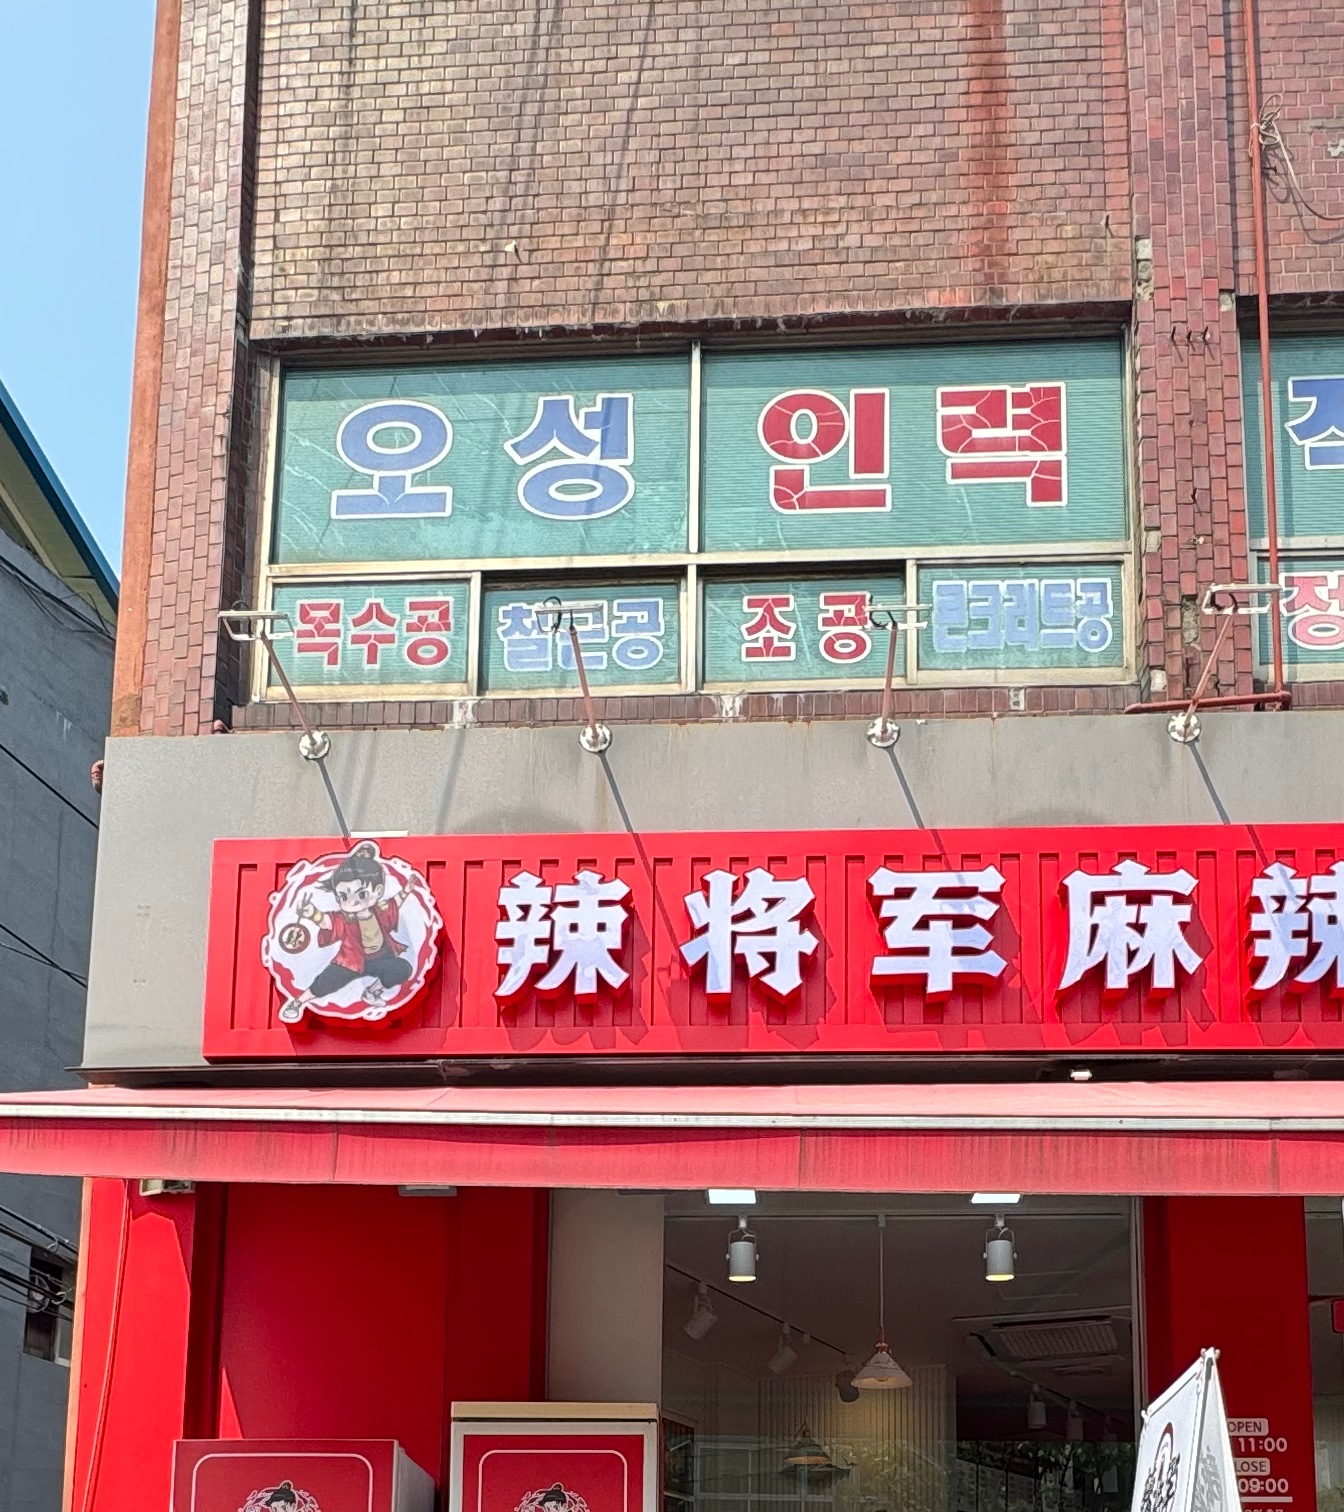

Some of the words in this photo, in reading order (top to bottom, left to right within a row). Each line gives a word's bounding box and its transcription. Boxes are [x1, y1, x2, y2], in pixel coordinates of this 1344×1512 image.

[330, 393, 635, 520] 오성
[757, 382, 1068, 514] 인력
[295, 596, 454, 671] 목수공
[741, 590, 873, 664] 조공
[1227, 1421, 1262, 1433] OPEN
[1238, 1437, 1288, 1453] 11:00
[1235, 1460, 1267, 1473] LOSE
[1237, 1478, 1289, 1494] 09:00
